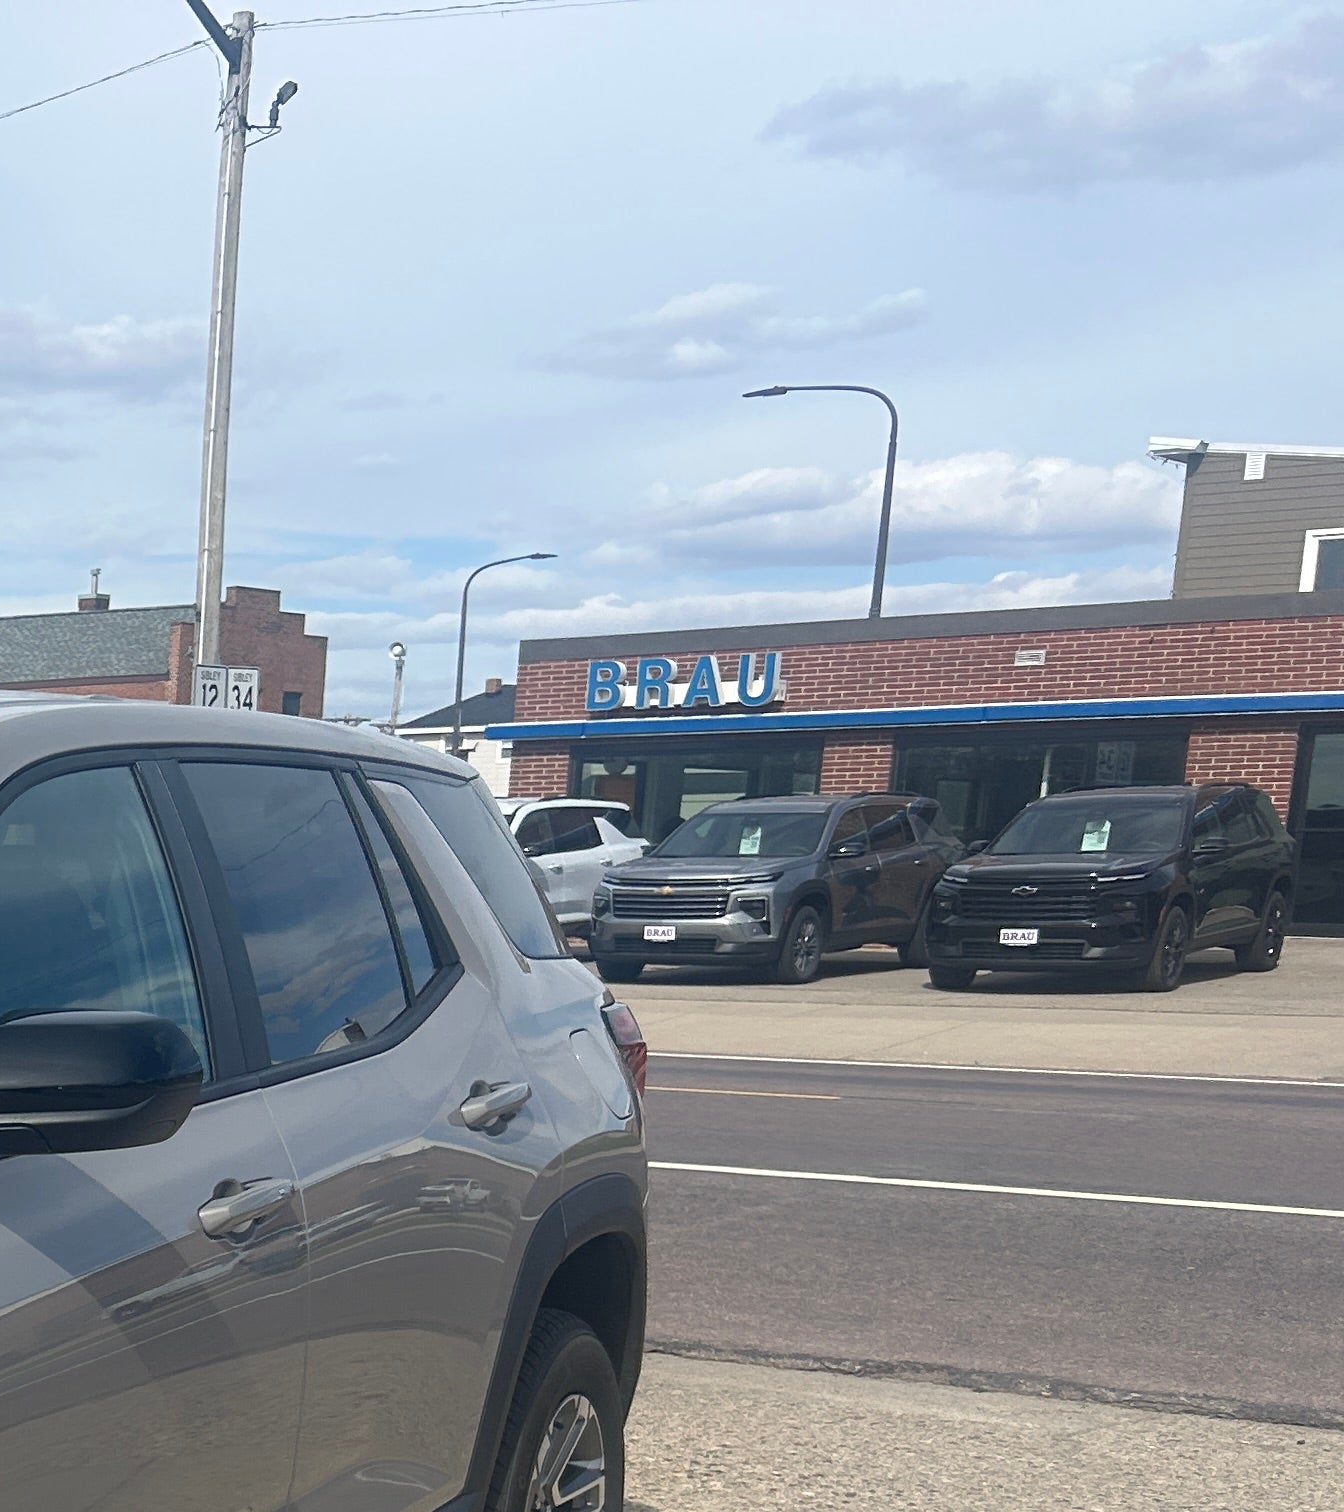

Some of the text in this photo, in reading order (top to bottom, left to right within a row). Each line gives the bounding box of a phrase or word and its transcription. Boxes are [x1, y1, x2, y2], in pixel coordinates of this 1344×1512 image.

[201, 671, 221, 681] SIBLEY
[585, 652, 781, 711] BRAU
[202, 683, 219, 707] 12
[230, 684, 253, 711] 34
[646, 928, 673, 937] BRAU
[1002, 932, 1035, 941] BRAU
